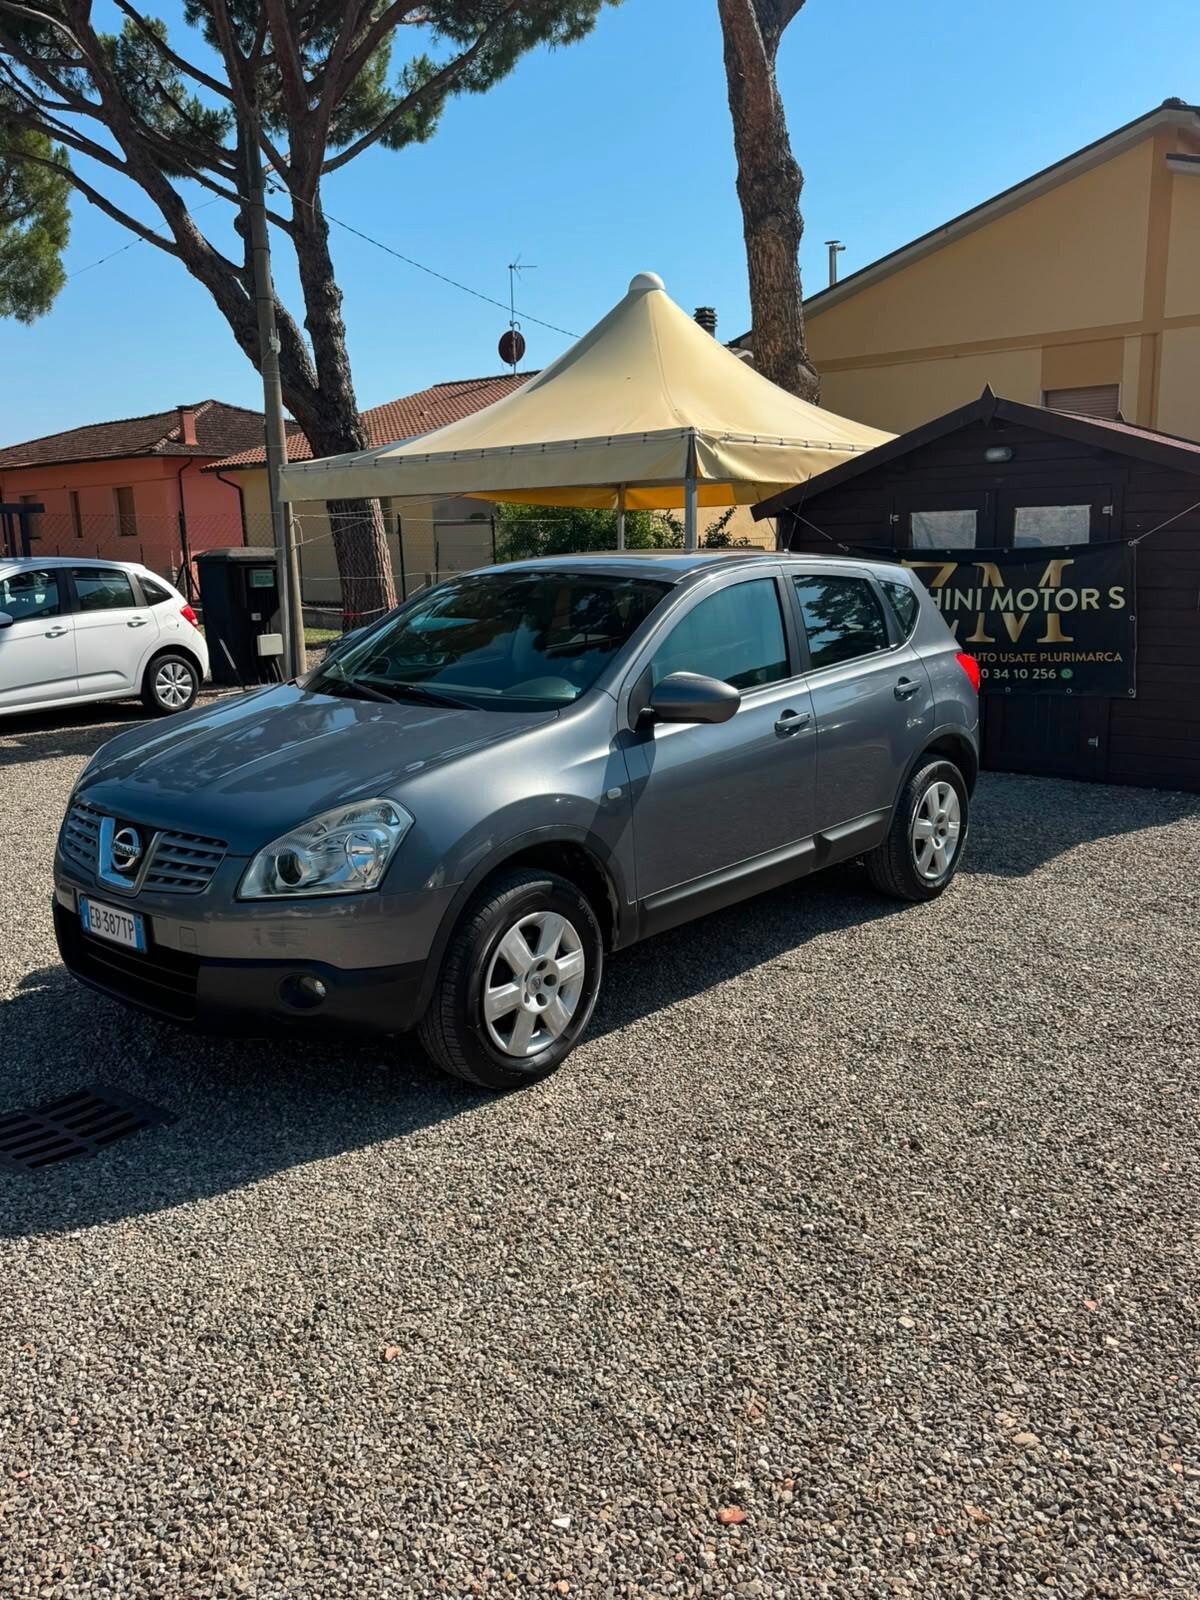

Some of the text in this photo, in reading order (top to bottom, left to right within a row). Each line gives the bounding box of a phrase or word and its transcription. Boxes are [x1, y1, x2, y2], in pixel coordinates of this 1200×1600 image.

[969, 652, 1123, 663] UTO USATE PLURIMARCA
[993, 668, 1009, 679] 34
[1013, 668, 1028, 679] 10
[1032, 668, 1056, 679] 256
